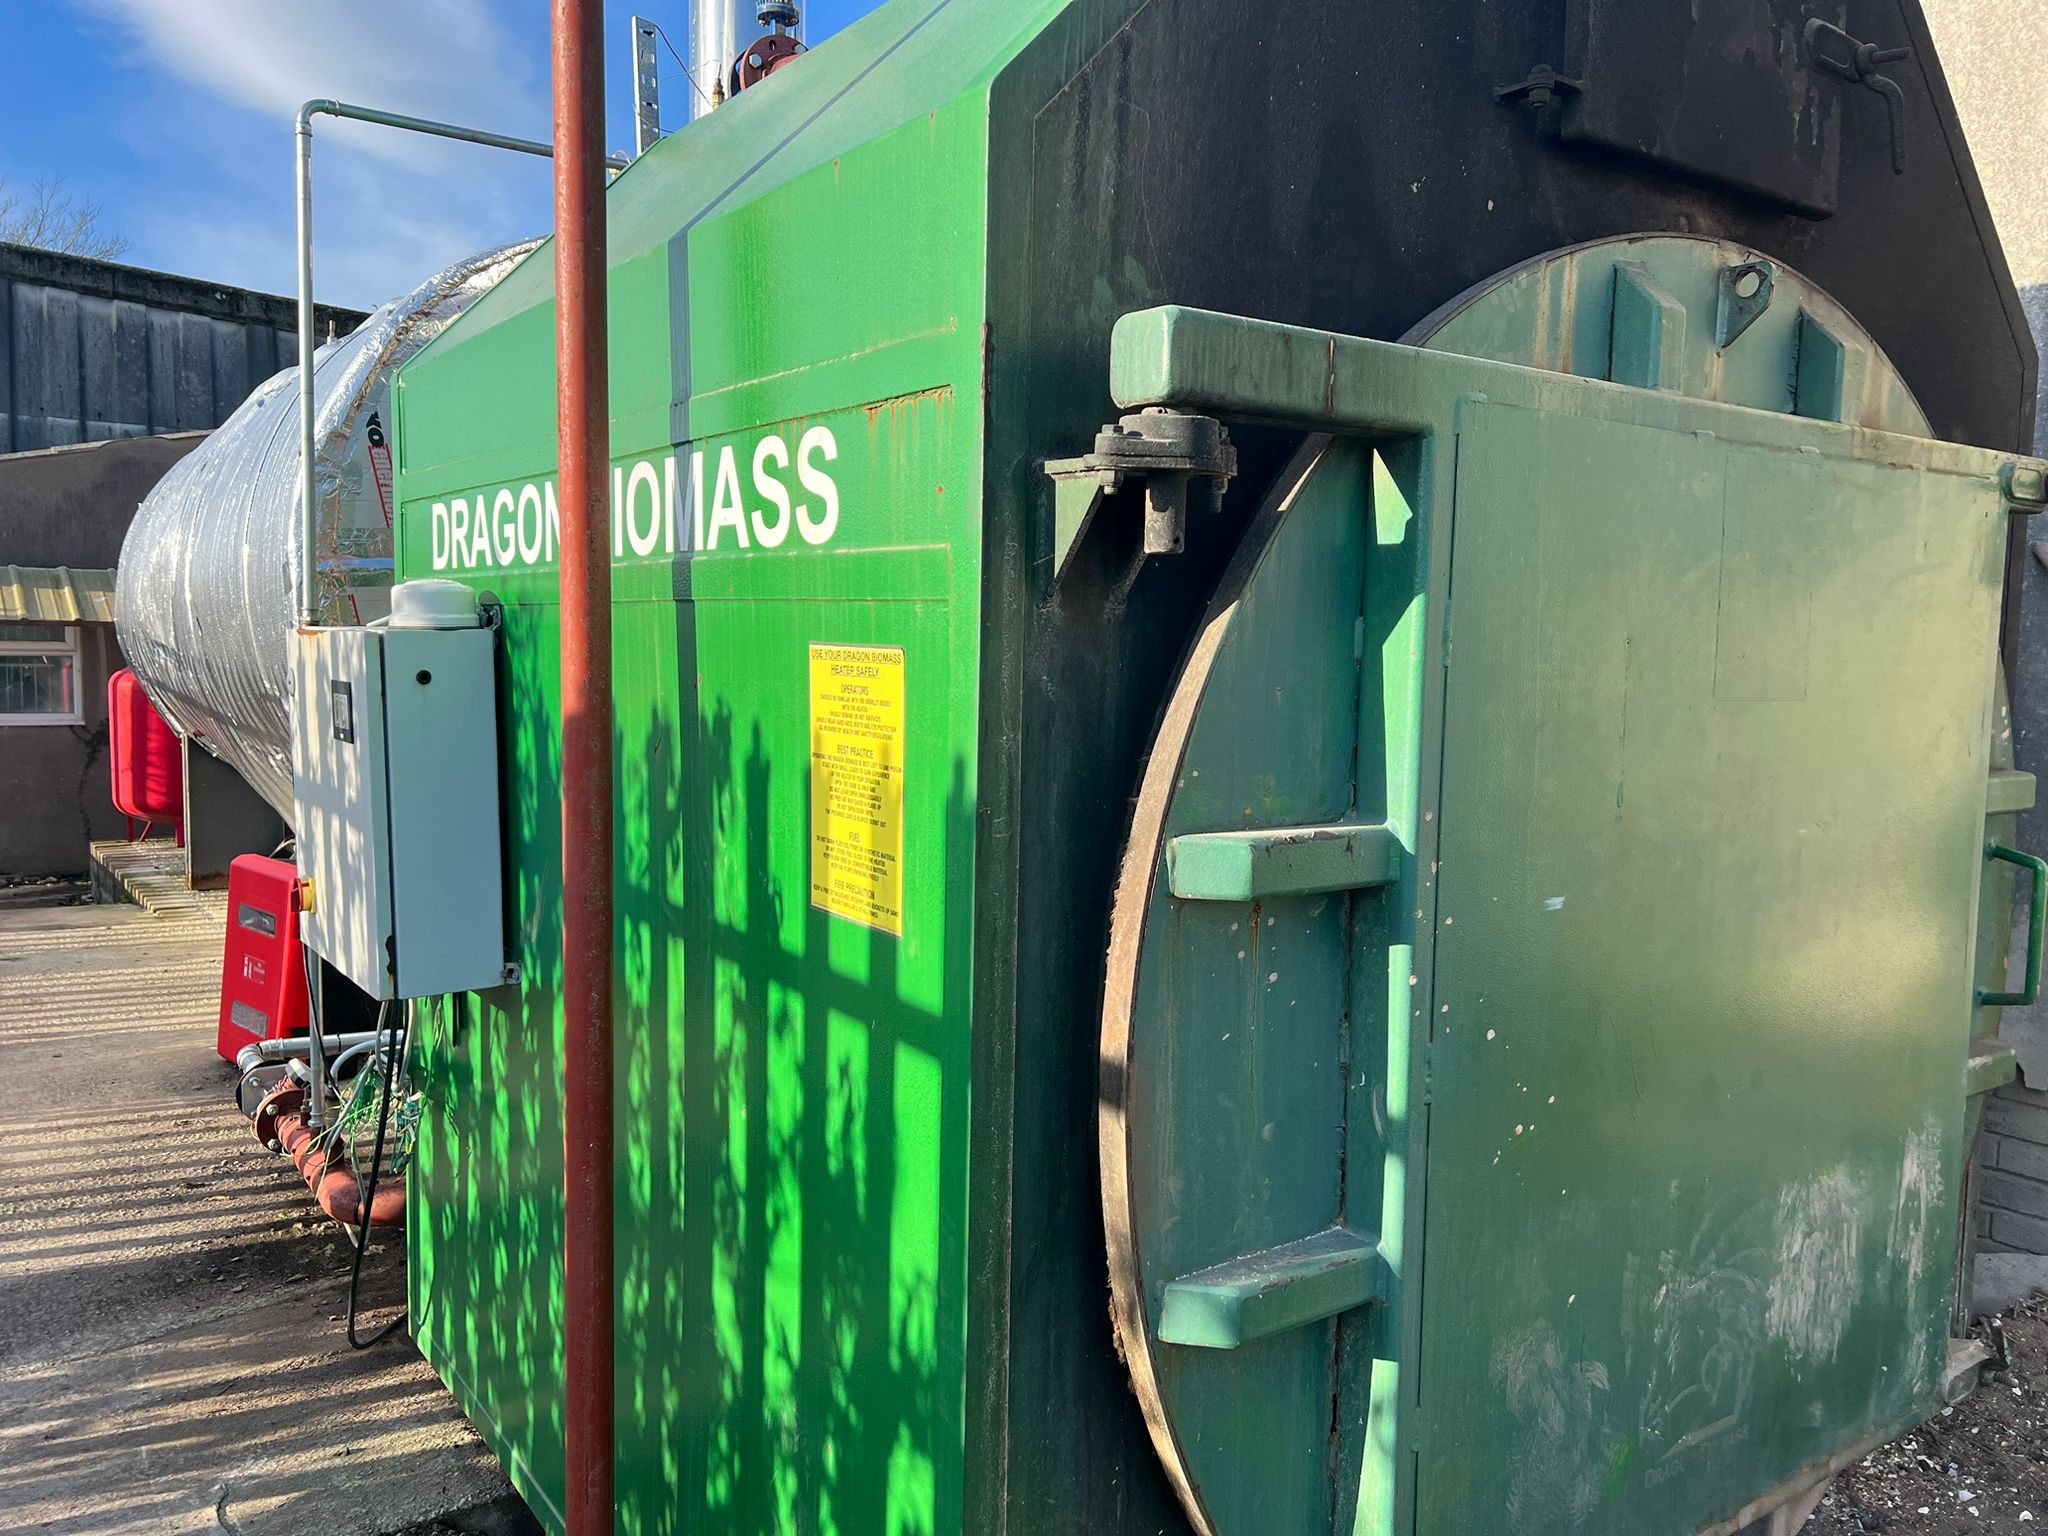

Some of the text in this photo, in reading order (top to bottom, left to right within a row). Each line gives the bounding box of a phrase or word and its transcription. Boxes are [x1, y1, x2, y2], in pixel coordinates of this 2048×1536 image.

[614, 425, 840, 557] IOMASS
[824, 649, 841, 660] YOUR
[843, 650, 870, 662] DRAGON
[872, 652, 902, 664] BIOMASS
[831, 664, 880, 678] HEATER SAFELY
[841, 684, 869, 696] OPERATORS
[837, 744, 874, 759] BEST PRACTICE
